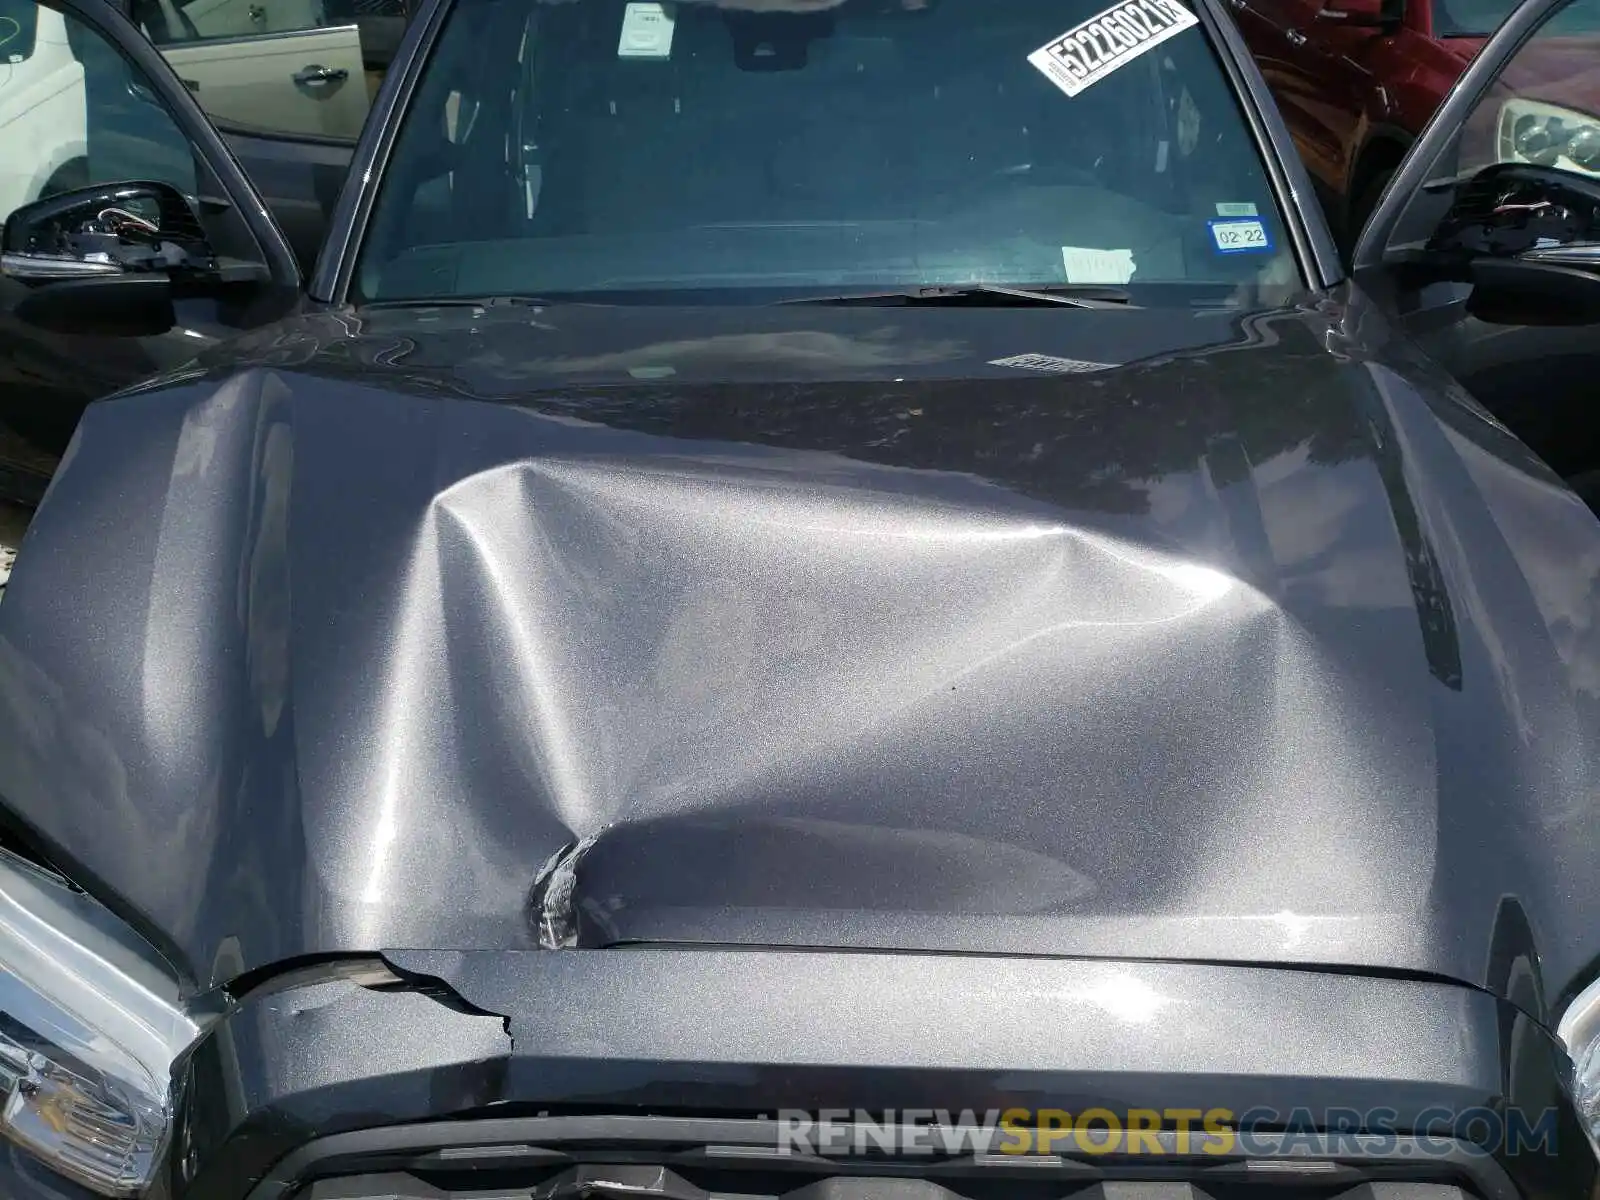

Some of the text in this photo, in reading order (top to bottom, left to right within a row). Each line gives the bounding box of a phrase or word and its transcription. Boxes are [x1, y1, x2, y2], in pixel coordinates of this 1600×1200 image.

[1049, 0, 1175, 78] 52226021
[1219, 229, 1265, 244] 02 22
